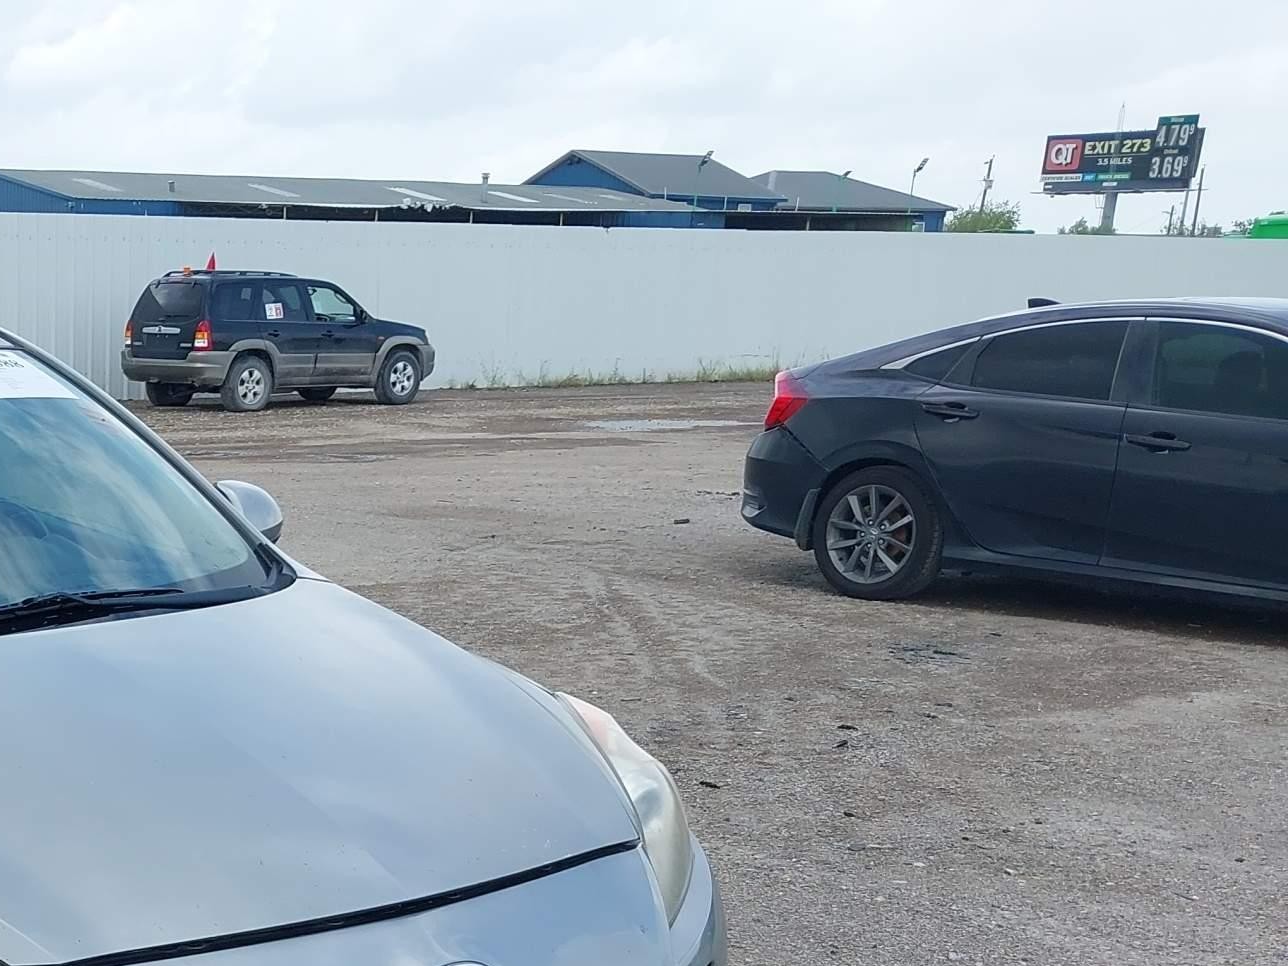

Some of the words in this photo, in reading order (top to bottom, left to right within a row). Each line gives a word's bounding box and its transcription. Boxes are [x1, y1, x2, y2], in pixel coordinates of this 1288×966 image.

[1084, 140, 1119, 154] EXIT
[1121, 138, 1151, 153] 273
[1051, 144, 1077, 166] QT
[1110, 157, 1133, 165] MILES
